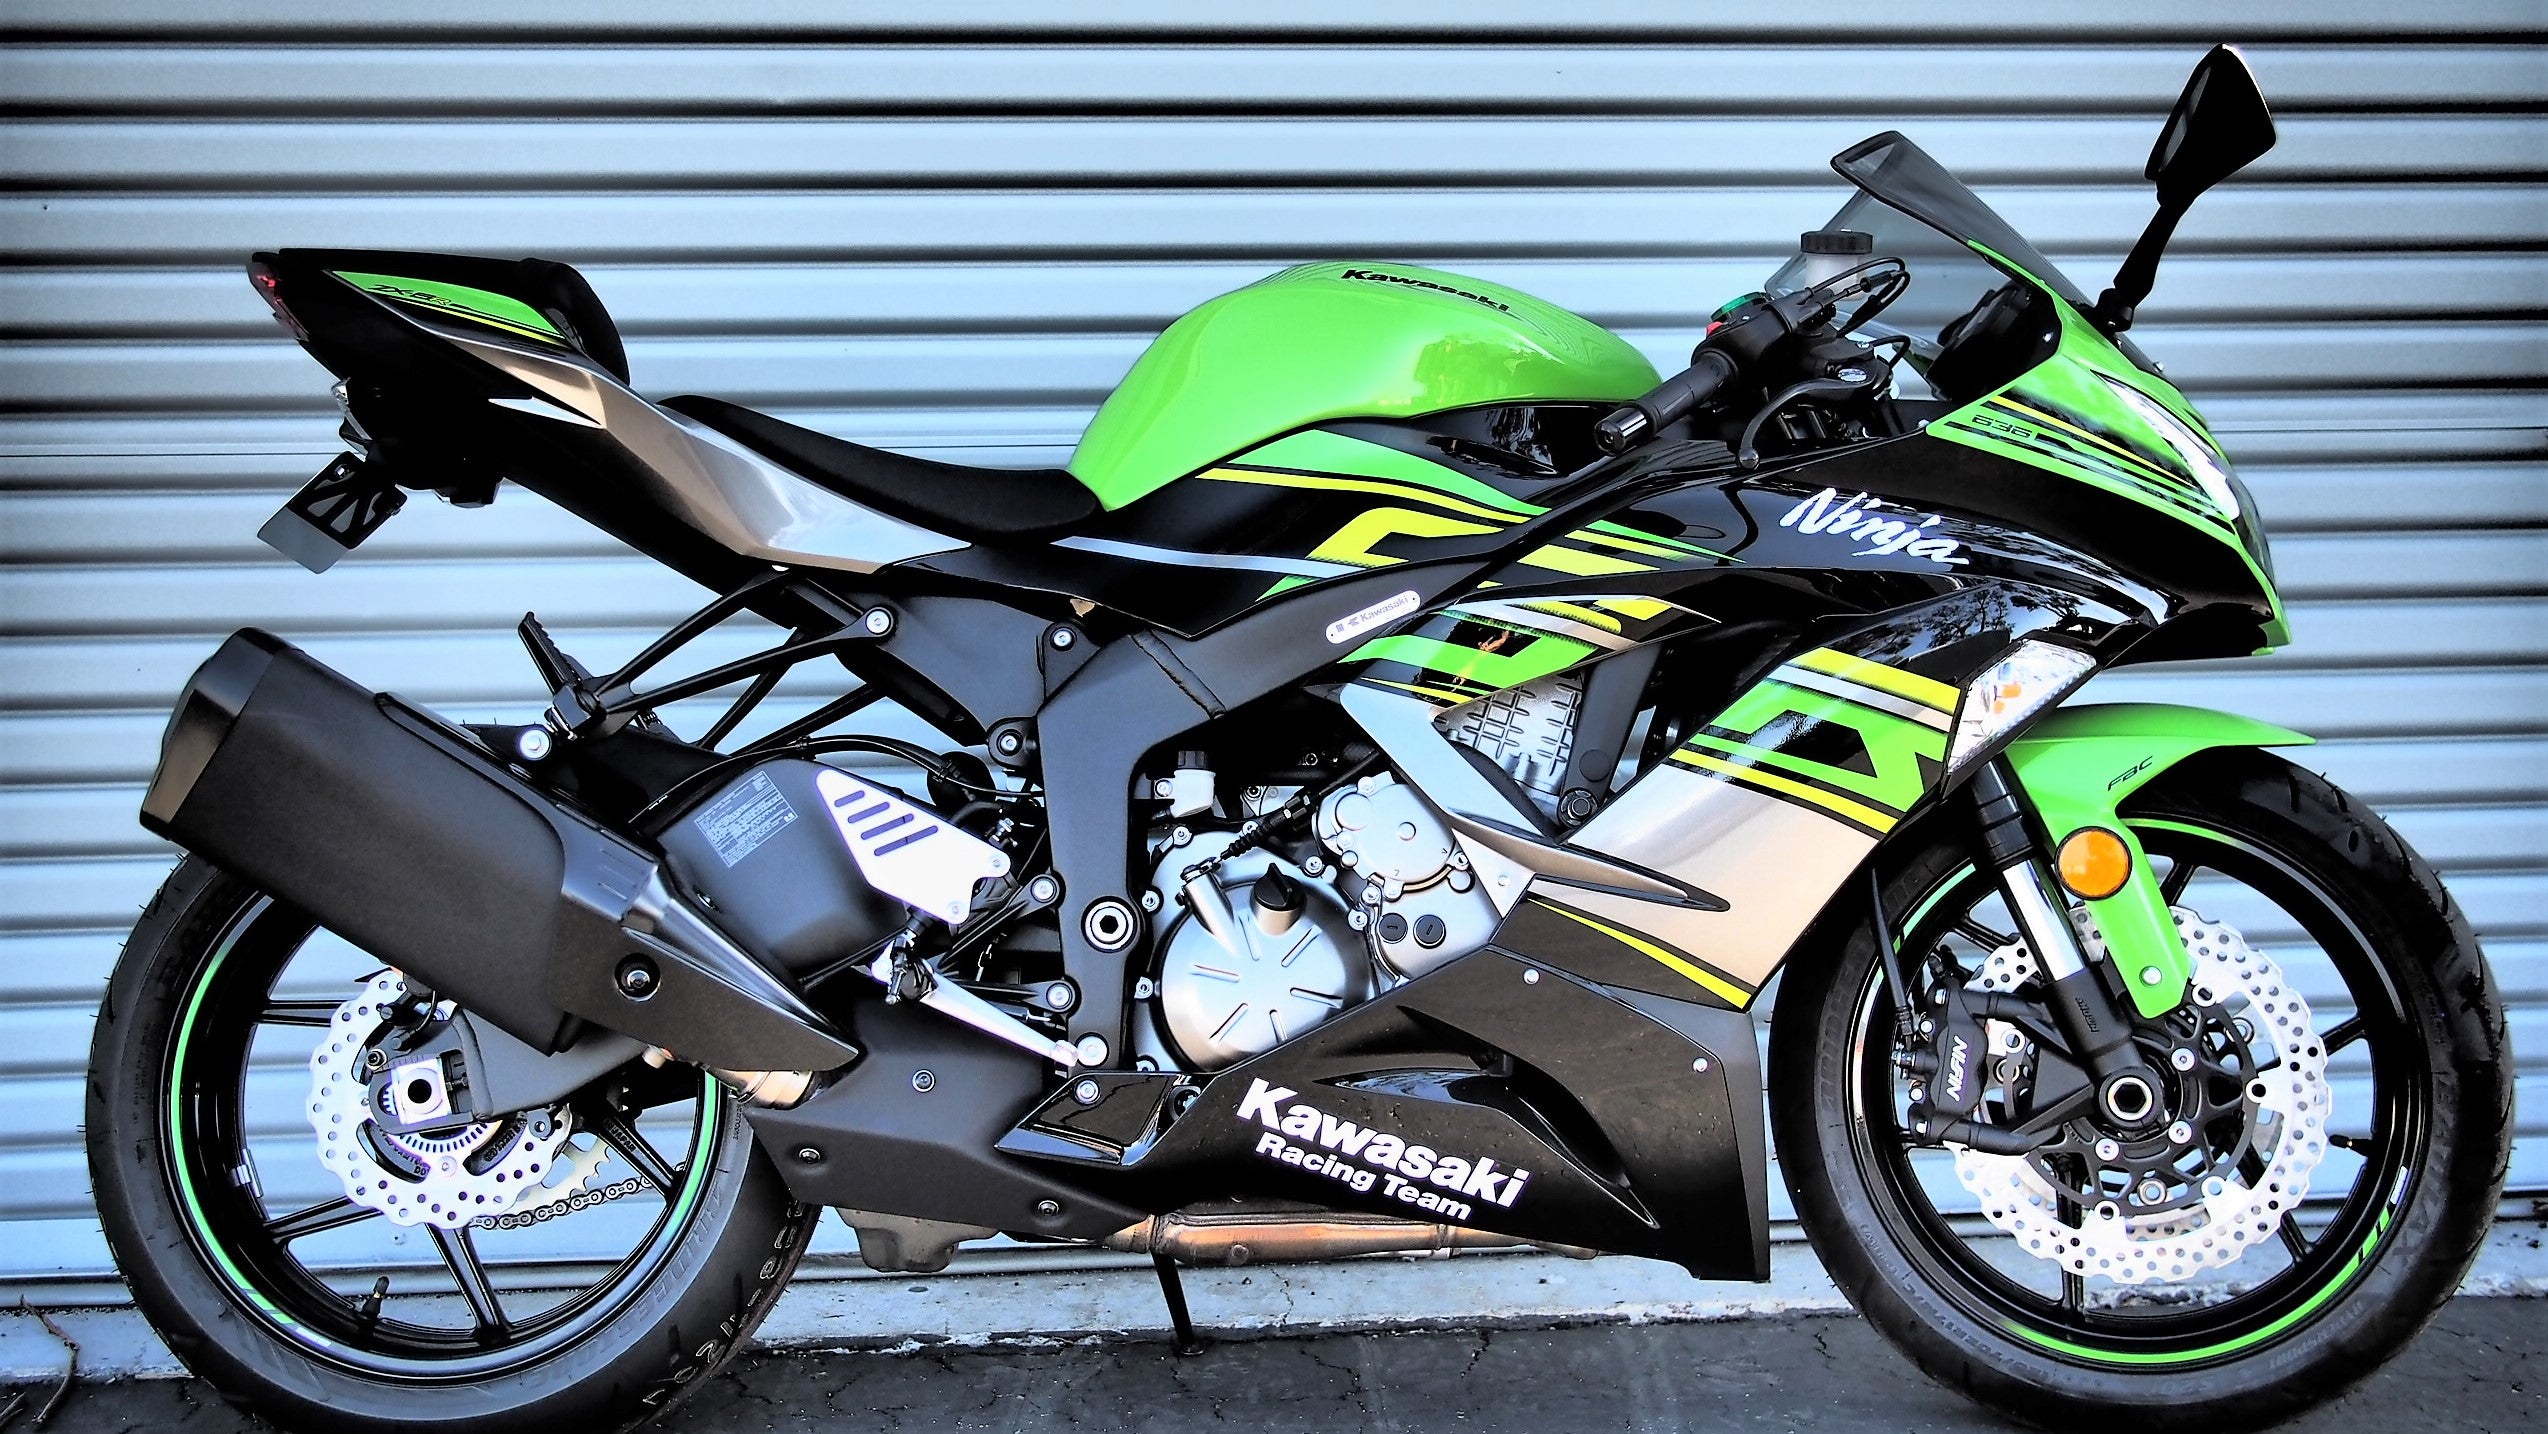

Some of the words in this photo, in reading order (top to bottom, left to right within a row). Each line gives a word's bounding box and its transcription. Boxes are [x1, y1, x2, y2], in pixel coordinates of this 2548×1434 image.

[1341, 269, 1510, 312] Kawasaki
[1972, 414, 2033, 438] 636
[1779, 487, 1970, 565] Ninja
[1359, 595, 1409, 623] Kawasaki
[1236, 1077, 1531, 1208] Kawasaki
[1255, 1132, 1378, 1193] Racing
[1381, 1173, 1473, 1221] Team
